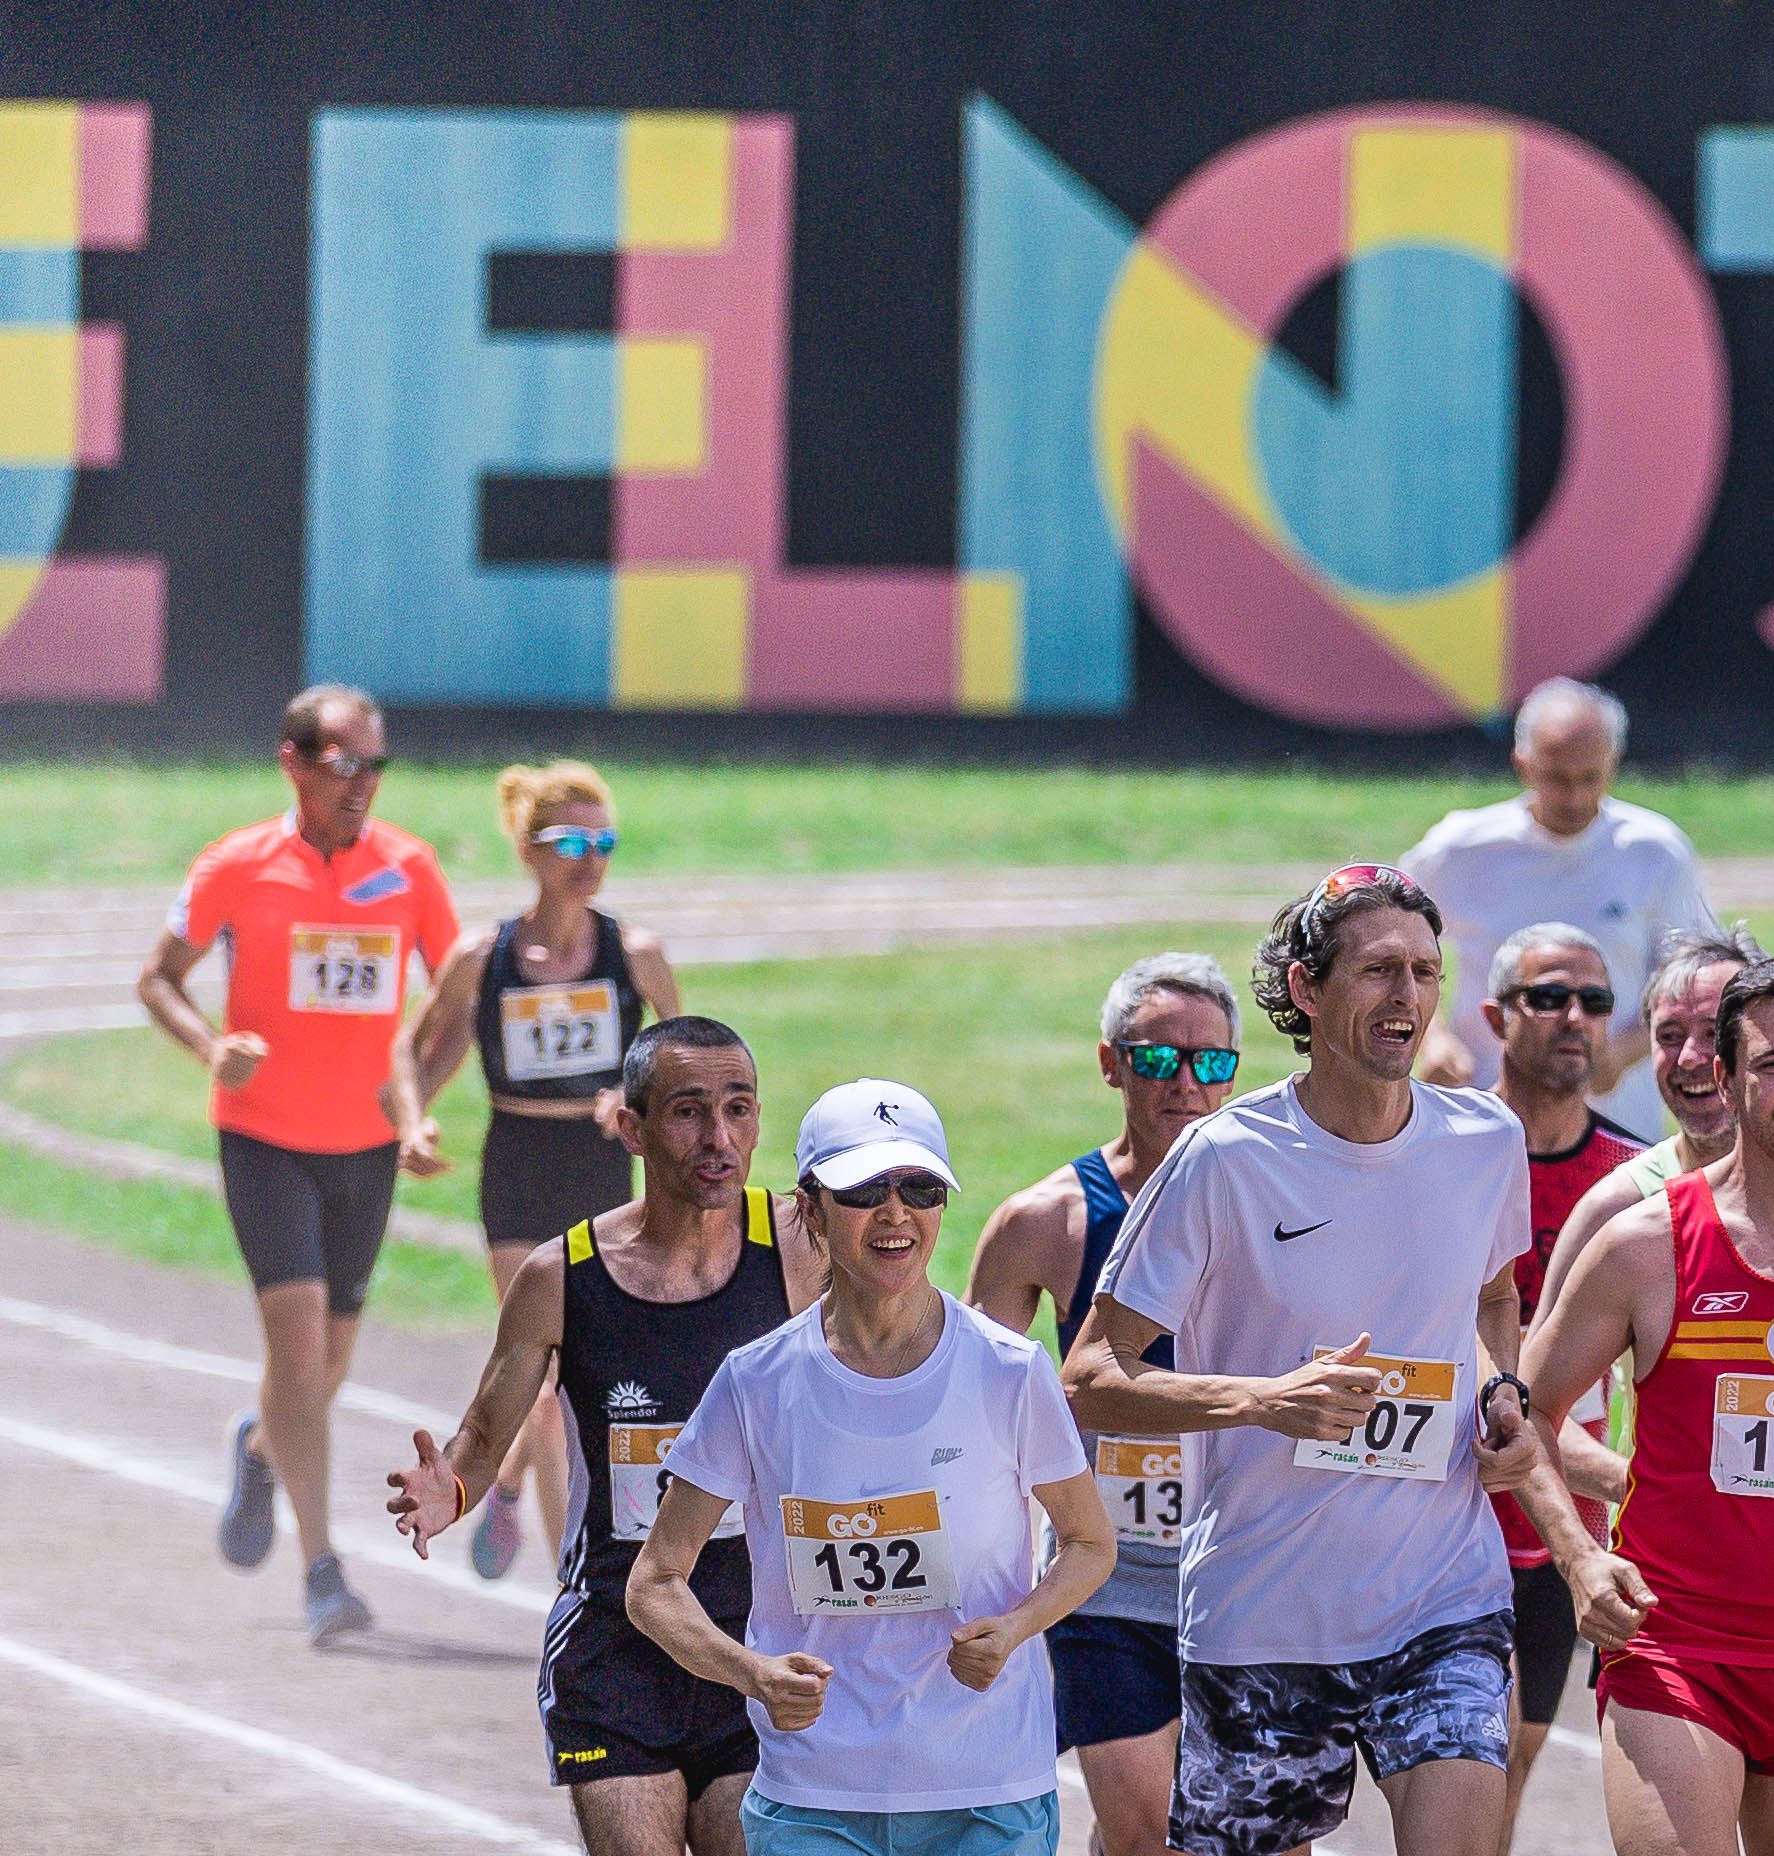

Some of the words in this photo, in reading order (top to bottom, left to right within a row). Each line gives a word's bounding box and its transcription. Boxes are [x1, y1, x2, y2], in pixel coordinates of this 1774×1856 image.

[530, 1019, 599, 1058] 122
[1726, 1380, 1739, 1411] 2022
[1340, 1400, 1435, 1453] 07
[792, 1501, 804, 1535] 2022
[827, 1512, 878, 1538] GO
[866, 1503, 887, 1517] fit
[814, 1539, 927, 1593] 132
